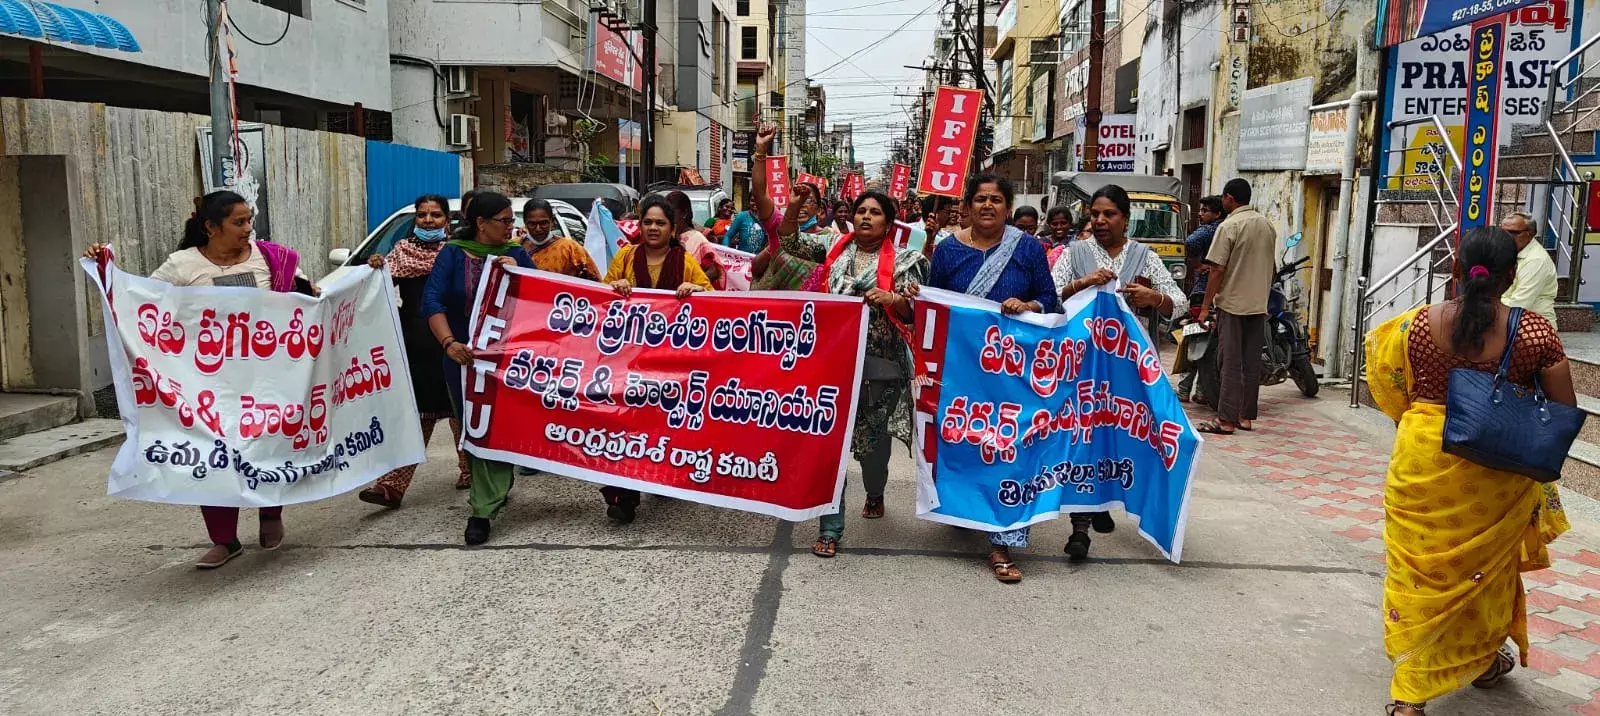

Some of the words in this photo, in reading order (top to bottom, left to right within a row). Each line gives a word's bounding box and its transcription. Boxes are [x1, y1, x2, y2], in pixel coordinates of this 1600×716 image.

[1452, 2, 1494, 21] #27-18-55,
[1401, 61, 1562, 89] PRAASH
[1101, 125, 1135, 138] OTEL
[1405, 97, 1539, 115] ENTERSES
[931, 94, 966, 191] IFTU
[1076, 143, 1135, 157] RADI
[772, 159, 787, 206] IFTU
[892, 167, 906, 199] IFTU
[137, 303, 186, 354] ఏపి
[194, 307, 324, 375] ప్రగతిశీల
[547, 292, 598, 336] ఏపి
[597, 301, 707, 355] ప్రగతిశీల
[466, 274, 511, 439] IFTU
[196, 389, 226, 439] &
[239, 383, 328, 450] హెల్పర్స్
[504, 349, 583, 411] వర్కర్స్
[585, 365, 615, 406] &
[624, 371, 710, 431] హెల్పర్స్
[709, 378, 839, 435] యూనియన్
[145, 438, 229, 480] ఉమ్మడి
[345, 416, 384, 456] కమిటీ
[545, 421, 669, 462] ఆంధ్రప్రదేశ్
[716, 452, 779, 482] కమిటీ
